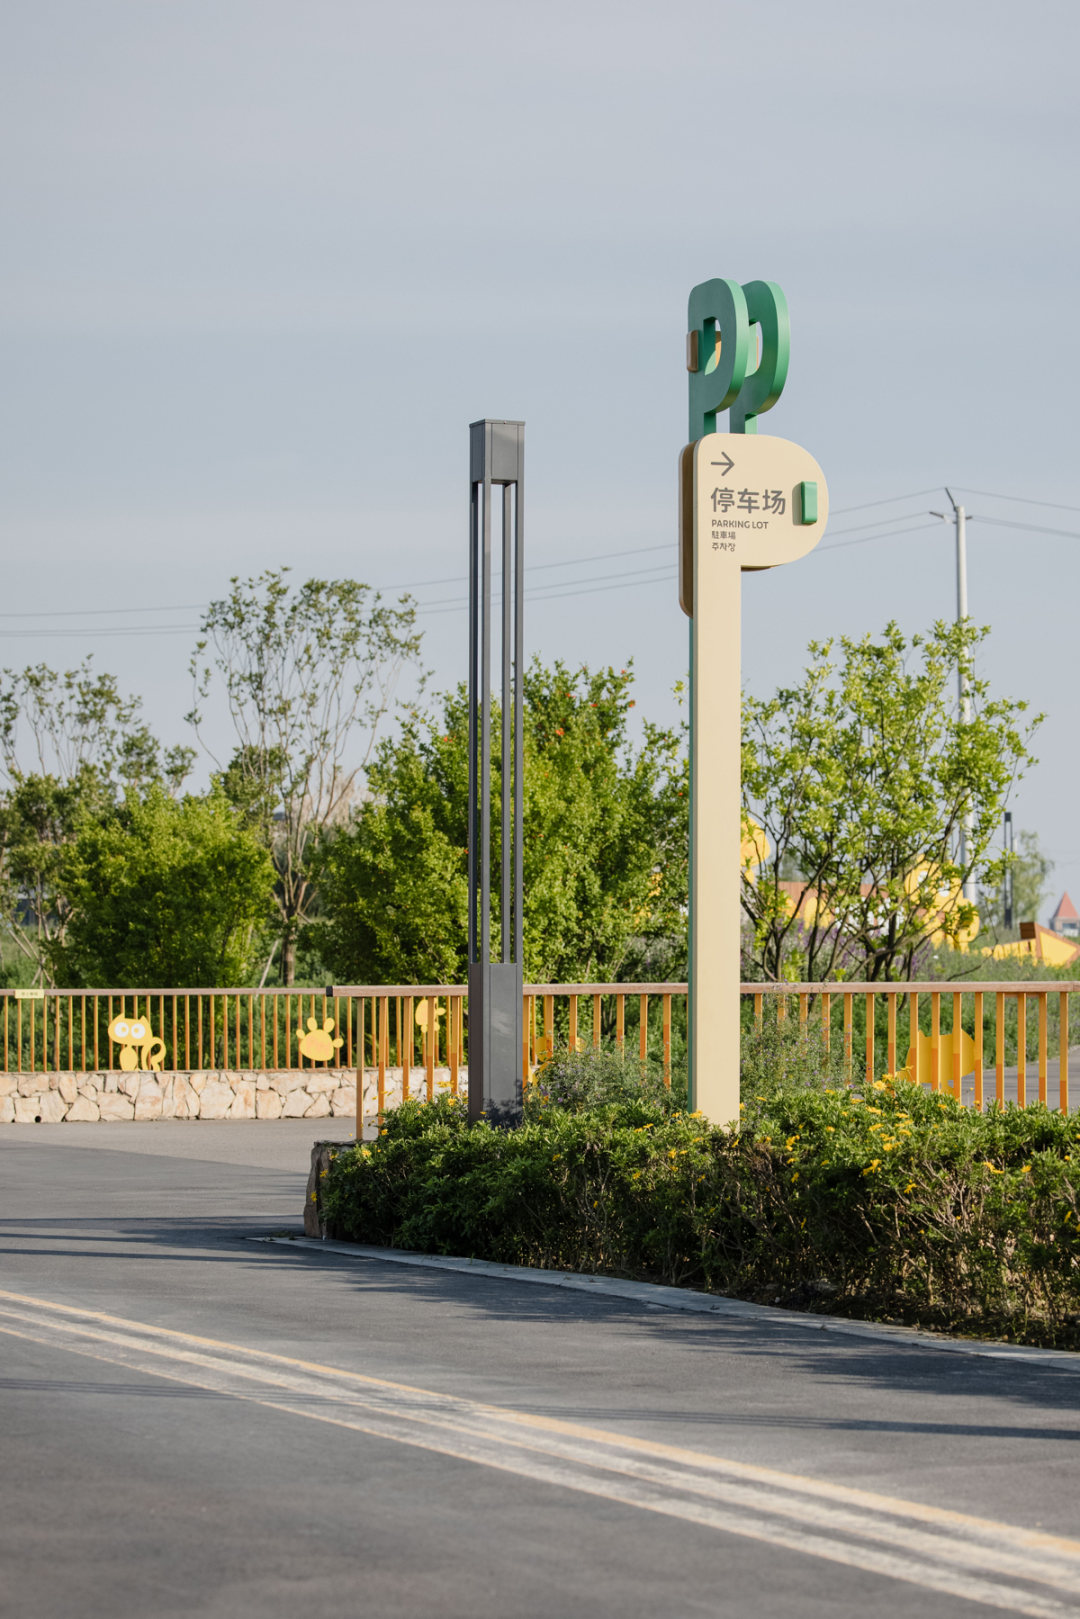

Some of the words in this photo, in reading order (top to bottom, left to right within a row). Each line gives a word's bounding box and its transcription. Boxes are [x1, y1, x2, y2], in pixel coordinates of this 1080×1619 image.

[710, 487, 786, 515] 停车场
[711, 519, 750, 528] PARKING
[752, 521, 769, 529] LOT
[711, 530, 736, 540] 駐車場
[711, 542, 736, 552] 주차장
